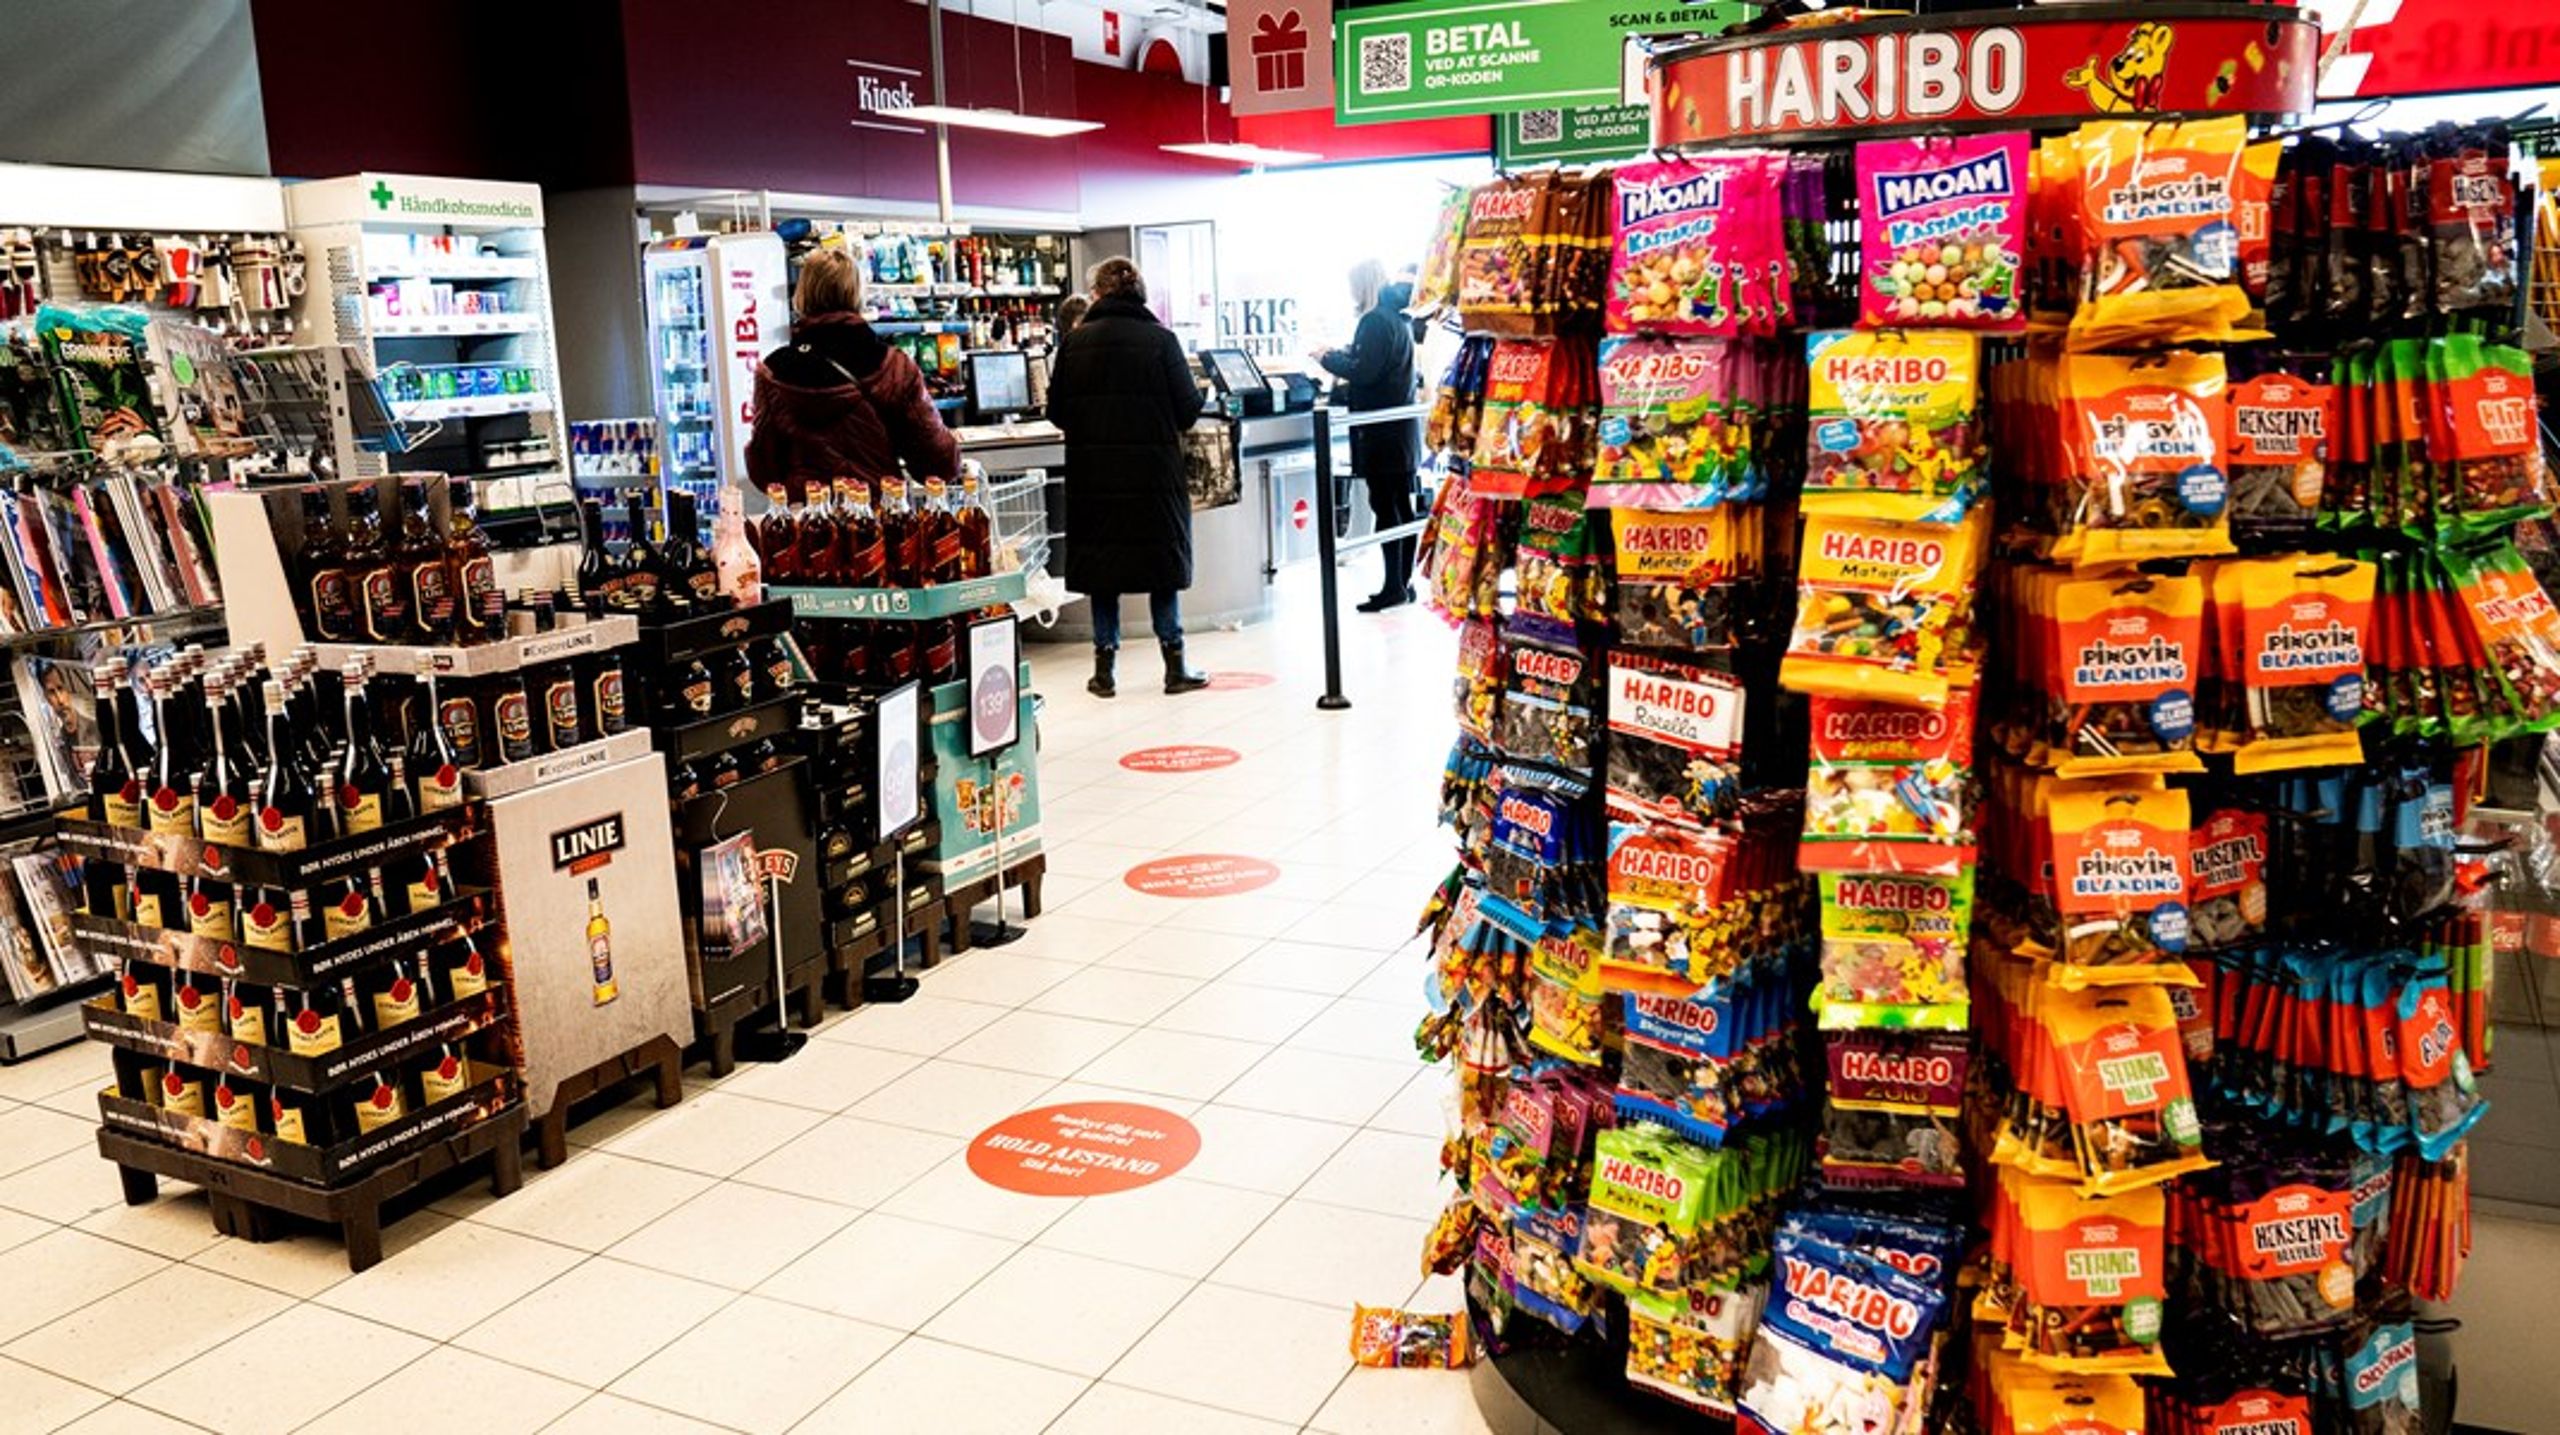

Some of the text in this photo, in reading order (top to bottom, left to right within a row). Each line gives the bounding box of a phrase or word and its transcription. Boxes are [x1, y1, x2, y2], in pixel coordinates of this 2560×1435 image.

[1609, 9, 1719, 28] SCAN & BETAL
[1425, 22, 1531, 56] BETAL
[1425, 50, 1541, 72] VED AT SCANNE
[1424, 70, 1504, 88] QR-KODEN
[1727, 24, 2025, 131] HARIBO
[857, 75, 917, 113] Kiosk
[1573, 113, 1598, 126] VED
[1600, 112, 1617, 124] AT
[1626, 173, 1723, 223] MAOAM
[1884, 158, 2004, 211] MAOAM
[1828, 357, 1947, 384] HARIBO
[1624, 526, 1710, 551] HARIBO
[1824, 534, 1942, 567] HARIBO
[2077, 664, 2185, 684] BLANDING
[2260, 651, 2361, 669] BLANDING
[1624, 677, 1715, 718] HARIBO
[1826, 712, 1946, 740] HARIBO
[354, 843, 386, 860] UNDER
[556, 821, 620, 863] LINIE
[1620, 847, 1713, 886] HARIBO
[1838, 882, 1951, 912] HARIBO
[2075, 877, 2180, 893] BLANDING
[364, 937, 396, 955] UNDER
[1638, 992, 1716, 1033] HARIBO
[379, 1037, 410, 1056] UNDER
[1842, 1053, 1951, 1085] HARIBO
[389, 1125, 420, 1147] UNDER
[1050, 1113, 1168, 1140] Beskyt dig selv
[1056, 1127, 1136, 1147] og andre!
[984, 1133, 1162, 1176] HOLD AFSTAND
[1602, 1156, 1683, 1203] HARIBO
[1784, 1254, 1922, 1339] HARIBO
